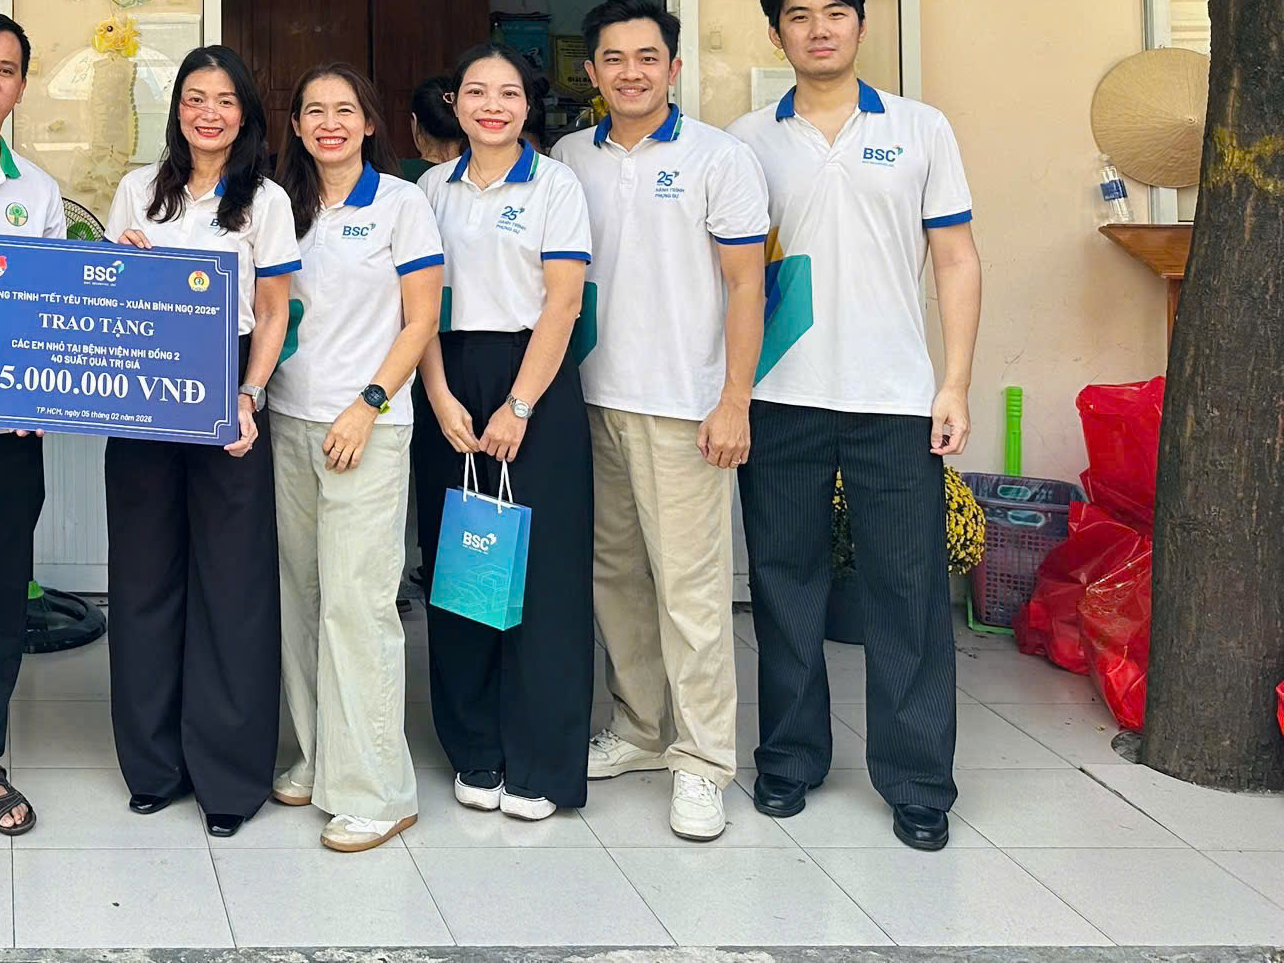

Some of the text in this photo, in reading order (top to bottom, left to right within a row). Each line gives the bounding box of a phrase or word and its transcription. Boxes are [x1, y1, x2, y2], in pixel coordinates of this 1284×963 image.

[863, 147, 896, 162] BSC
[657, 171, 673, 186] 25
[501, 205, 518, 221] 25
[342, 225, 369, 236] BSC
[84, 265, 116, 282] BSC
[12, 291, 39, 302] TRÌNH
[63, 294, 81, 305] YÊU
[82, 297, 118, 308] THƯƠNG
[126, 299, 151, 311] XUÂN
[152, 301, 174, 312] BÍNH
[175, 304, 193, 316] NGỌ
[38, 312, 155, 338] TRAO TẶNG
[11, 338, 30, 349] CÁC
[31, 340, 45, 350] EM
[46, 341, 65, 352] NHỎ
[66, 343, 81, 355] TẠI
[82, 343, 107, 356] BỆNH
[108, 345, 129, 358] VIỆN
[130, 348, 147, 358] NHI
[174, 352, 180, 361] 2
[50, 353, 141, 370] 40 SUẤT QUÀ TRỊ GIÁ
[136, 375, 206, 404] VNĐ
[36, 406, 63, 415] TP.HCM,
[64, 409, 81, 418] ngày
[81, 409, 90, 418] 05
[91, 411, 110, 421] tháng
[110, 412, 120, 420] 02
[136, 415, 153, 423] 2026
[463, 531, 489, 550] BSC
